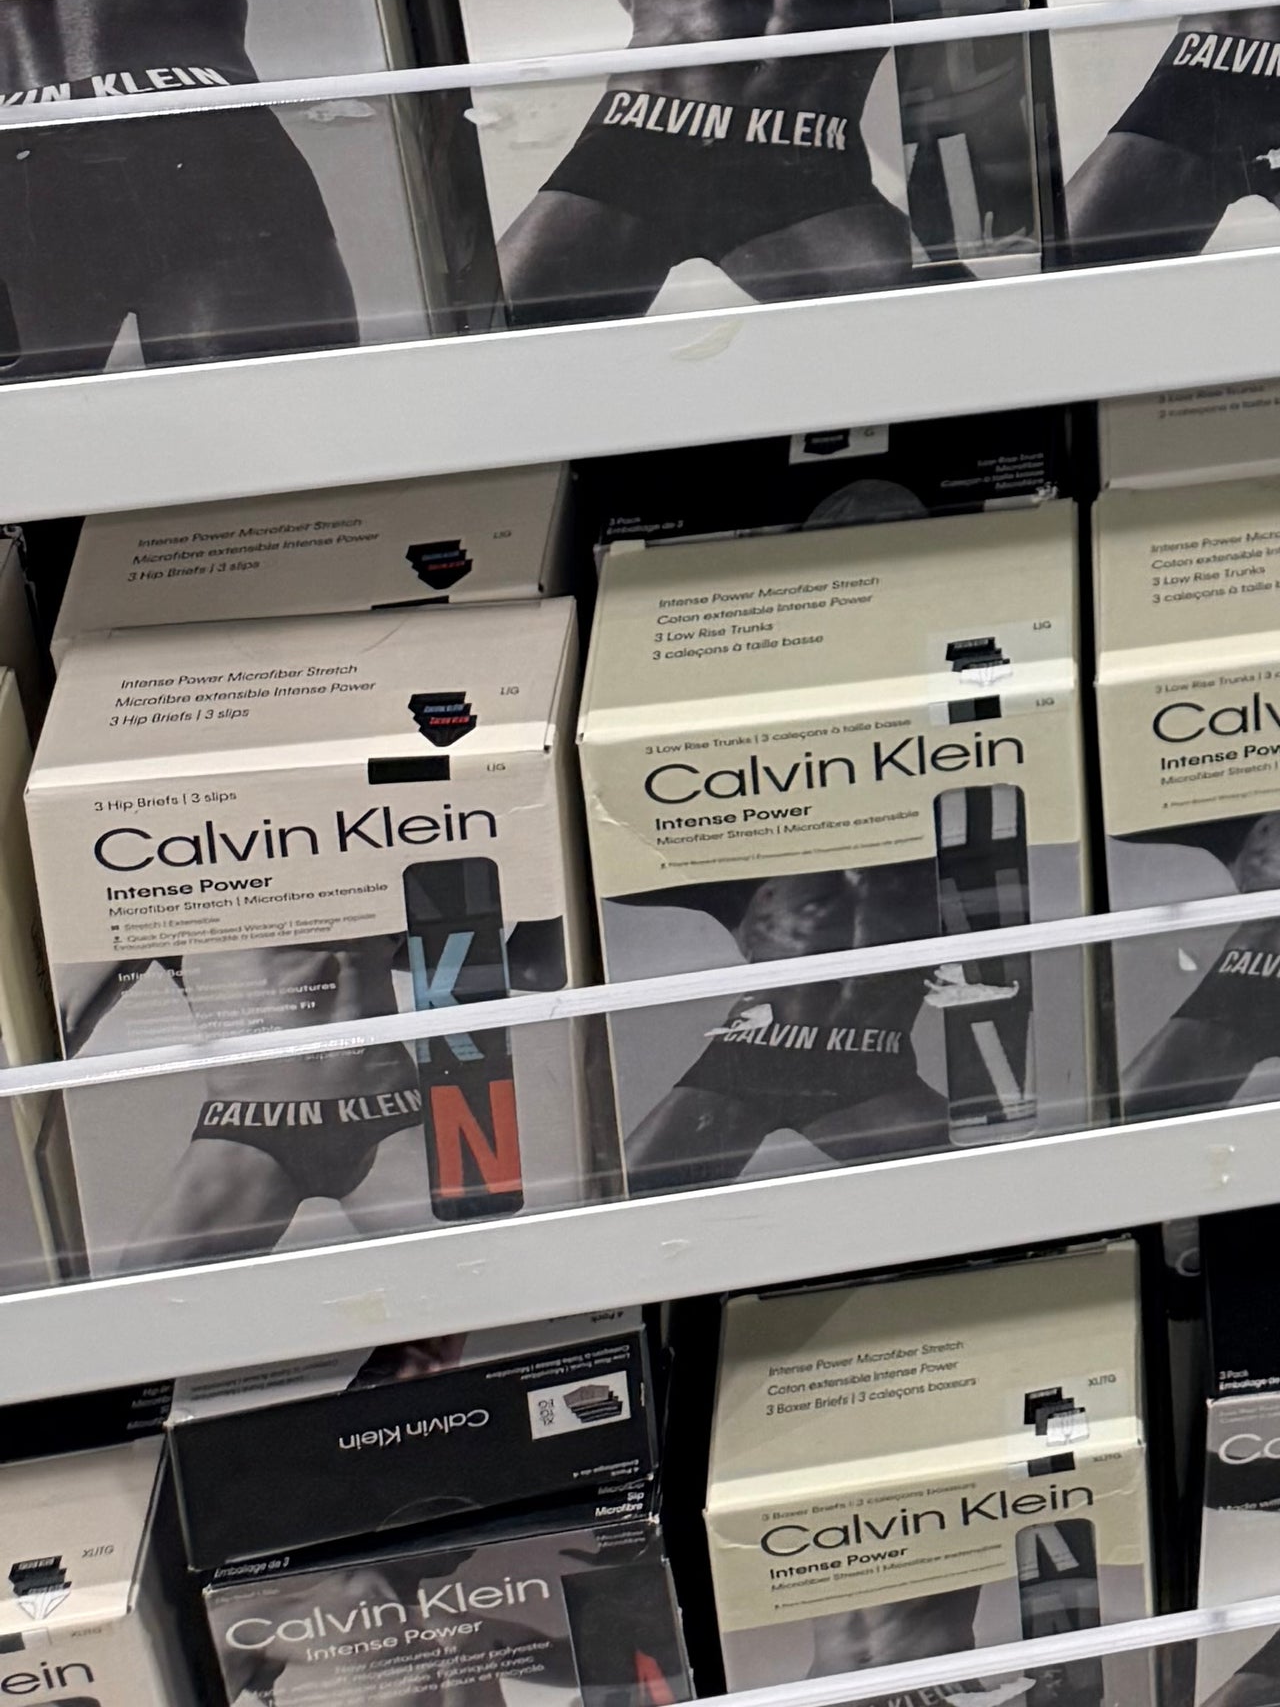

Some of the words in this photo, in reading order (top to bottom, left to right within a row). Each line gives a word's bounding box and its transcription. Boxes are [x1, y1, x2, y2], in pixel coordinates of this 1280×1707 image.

[645, 752, 855, 804] Calvin
[874, 732, 1023, 781] Klein
[94, 819, 319, 871] Calvin
[336, 804, 497, 852] Klein
[338, 1425, 402, 1450] Klein
[405, 1408, 490, 1437] Calvin
[757, 1504, 945, 1558] Calvin
[958, 1482, 1094, 1527] Klein
[224, 1601, 406, 1649] Calvin
[416, 1576, 550, 1622] Klein
